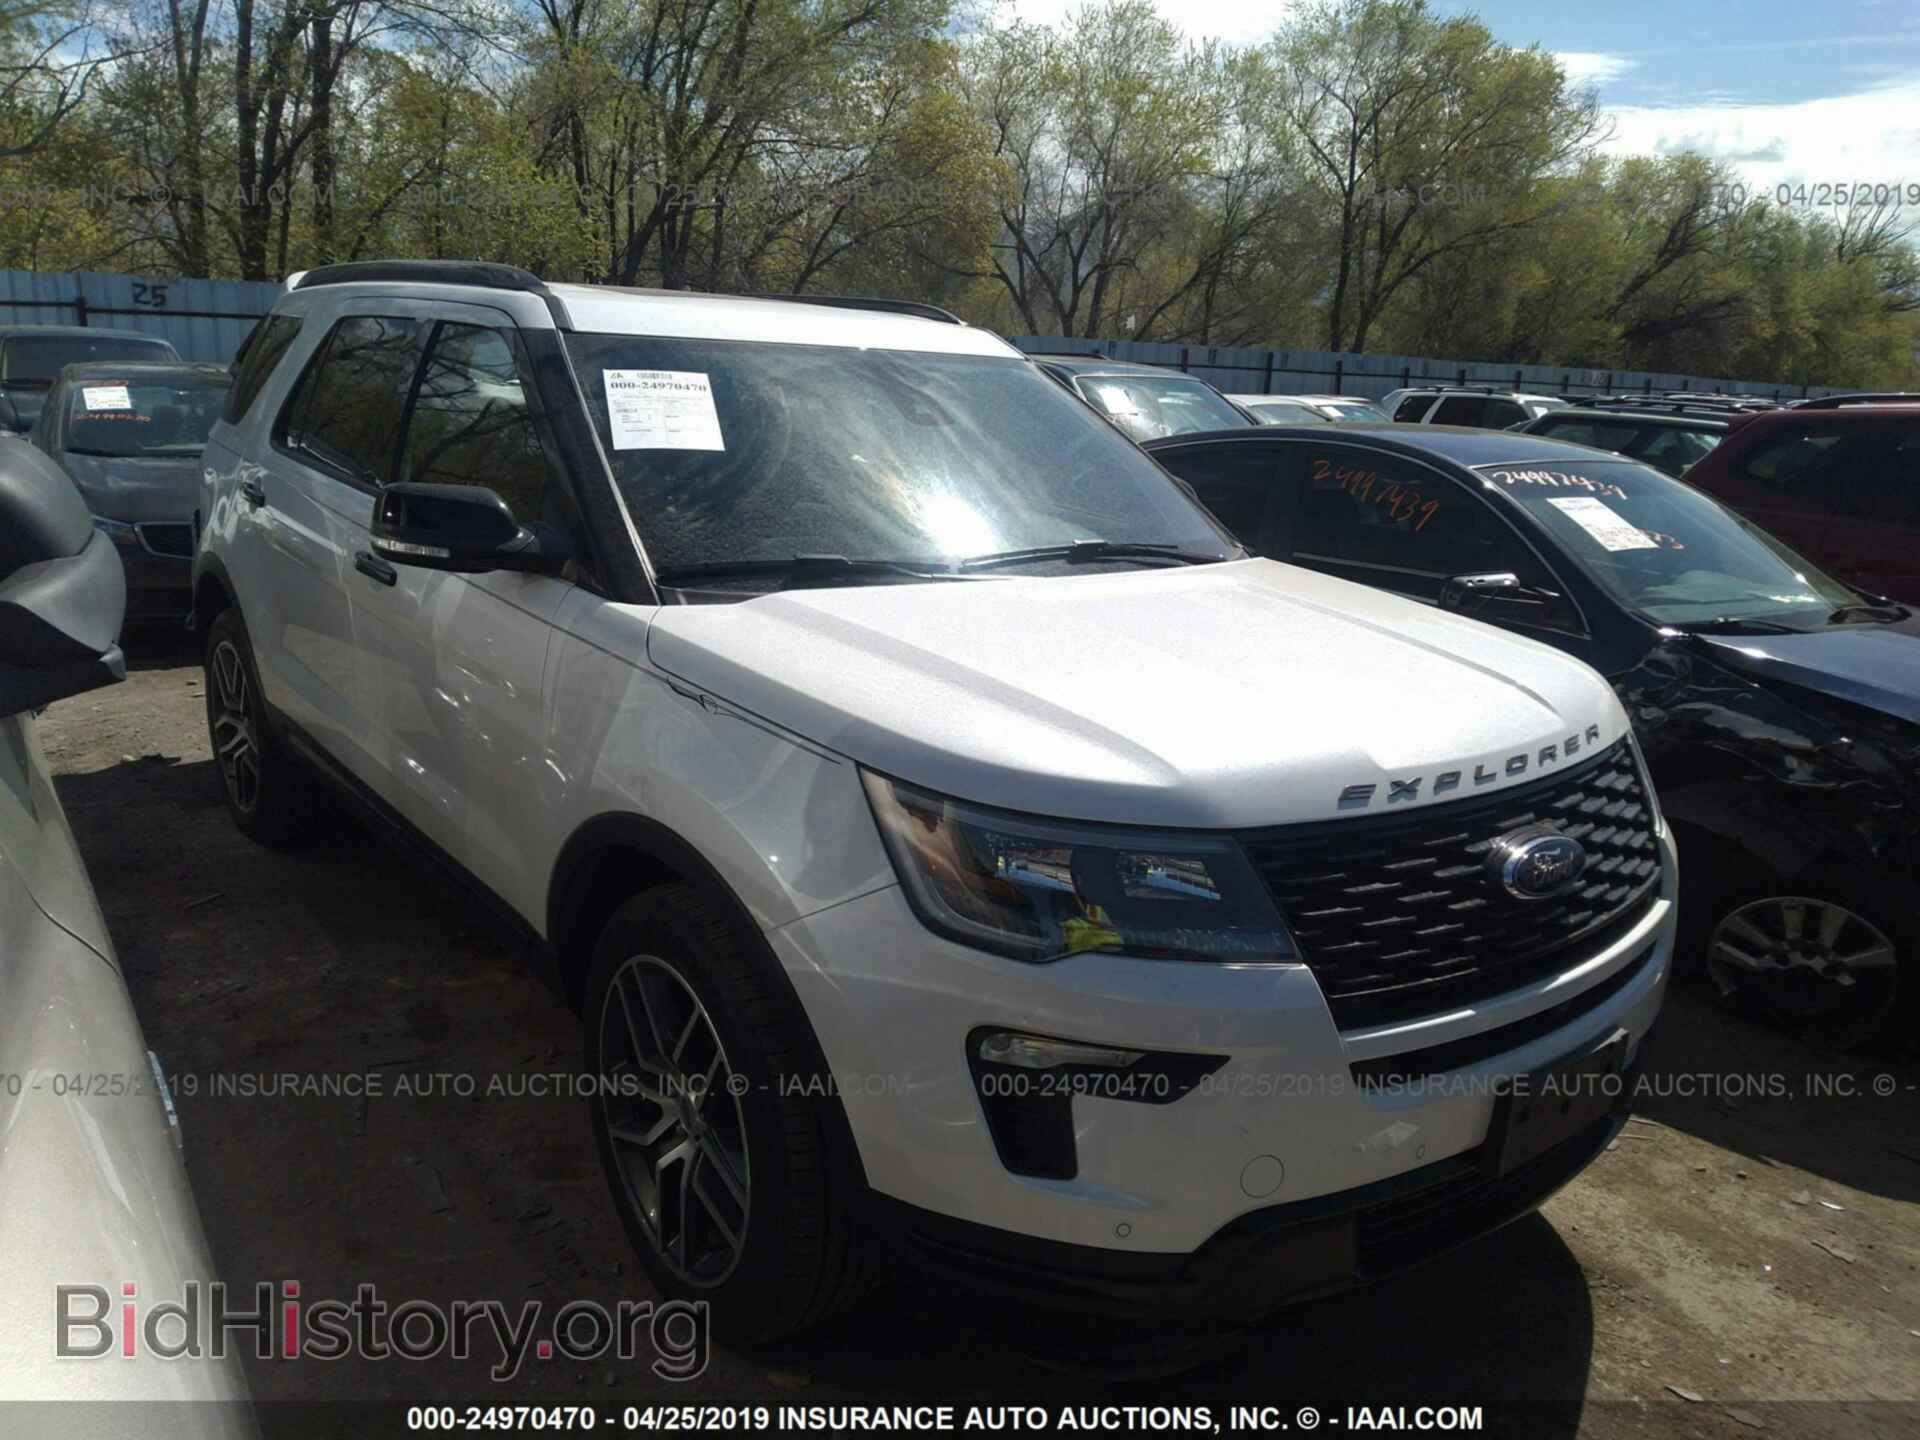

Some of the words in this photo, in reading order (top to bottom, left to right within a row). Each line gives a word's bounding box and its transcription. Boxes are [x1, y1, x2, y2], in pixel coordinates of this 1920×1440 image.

[131, 282, 168, 307] 25
[610, 381, 708, 392] 000-24970470
[1337, 723, 1600, 811] EXPLORER
